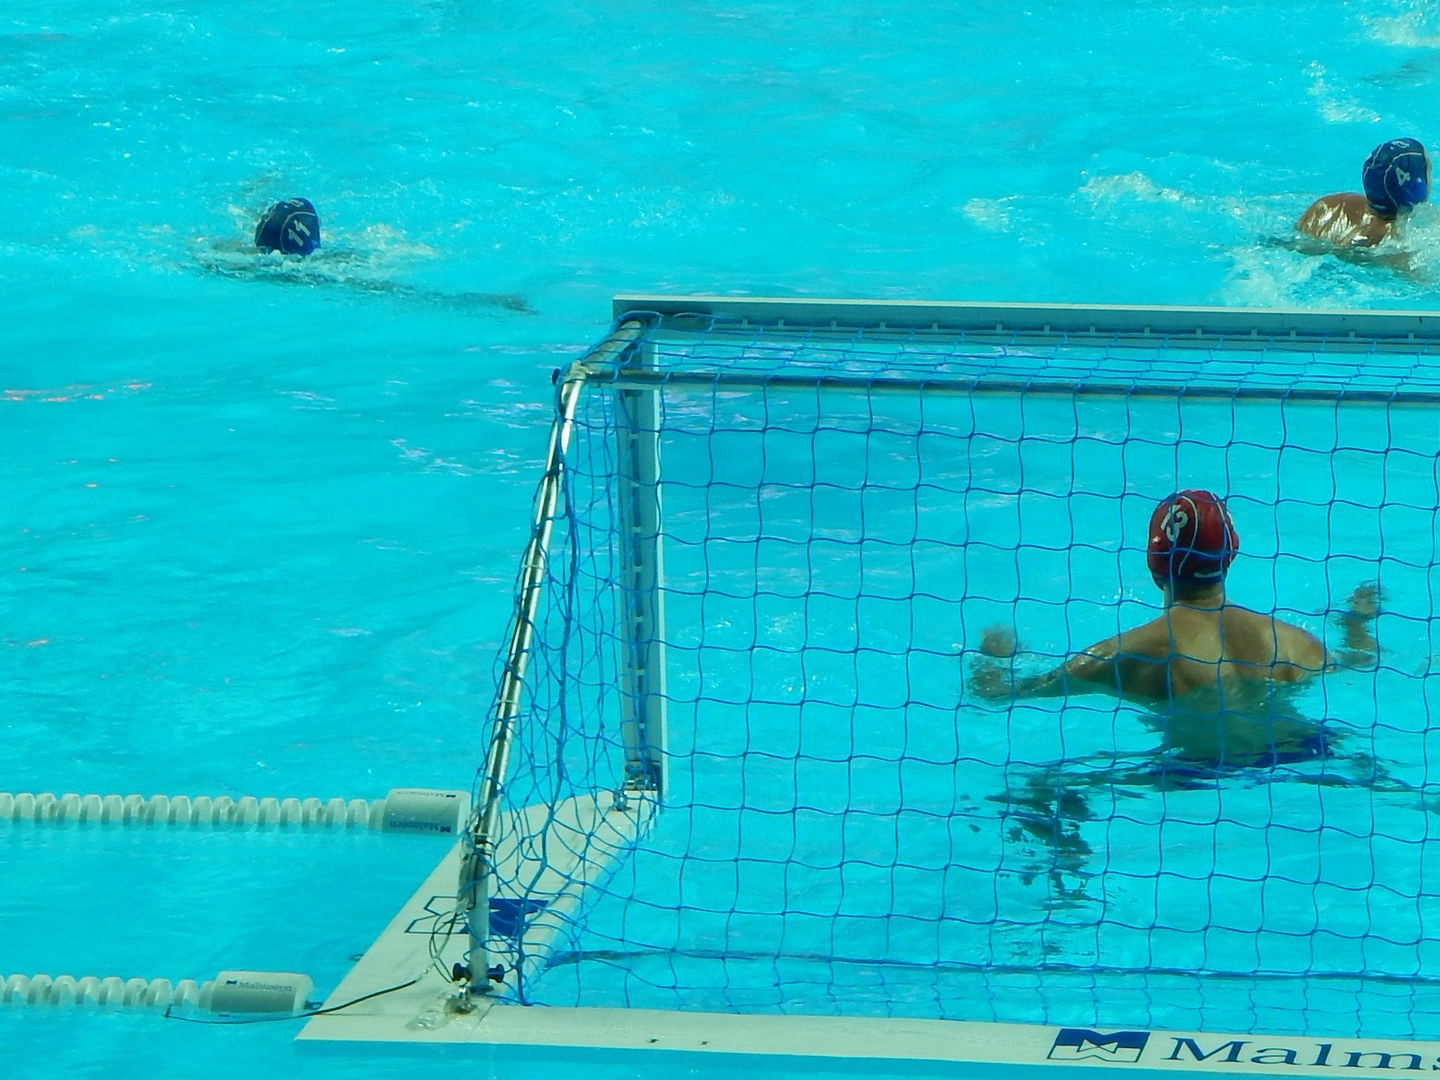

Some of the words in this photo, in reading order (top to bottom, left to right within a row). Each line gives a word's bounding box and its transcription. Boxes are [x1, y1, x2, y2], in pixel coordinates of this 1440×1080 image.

[1395, 166, 1411, 187] 4
[288, 219, 311, 247] 11
[1160, 504, 1189, 541] 13
